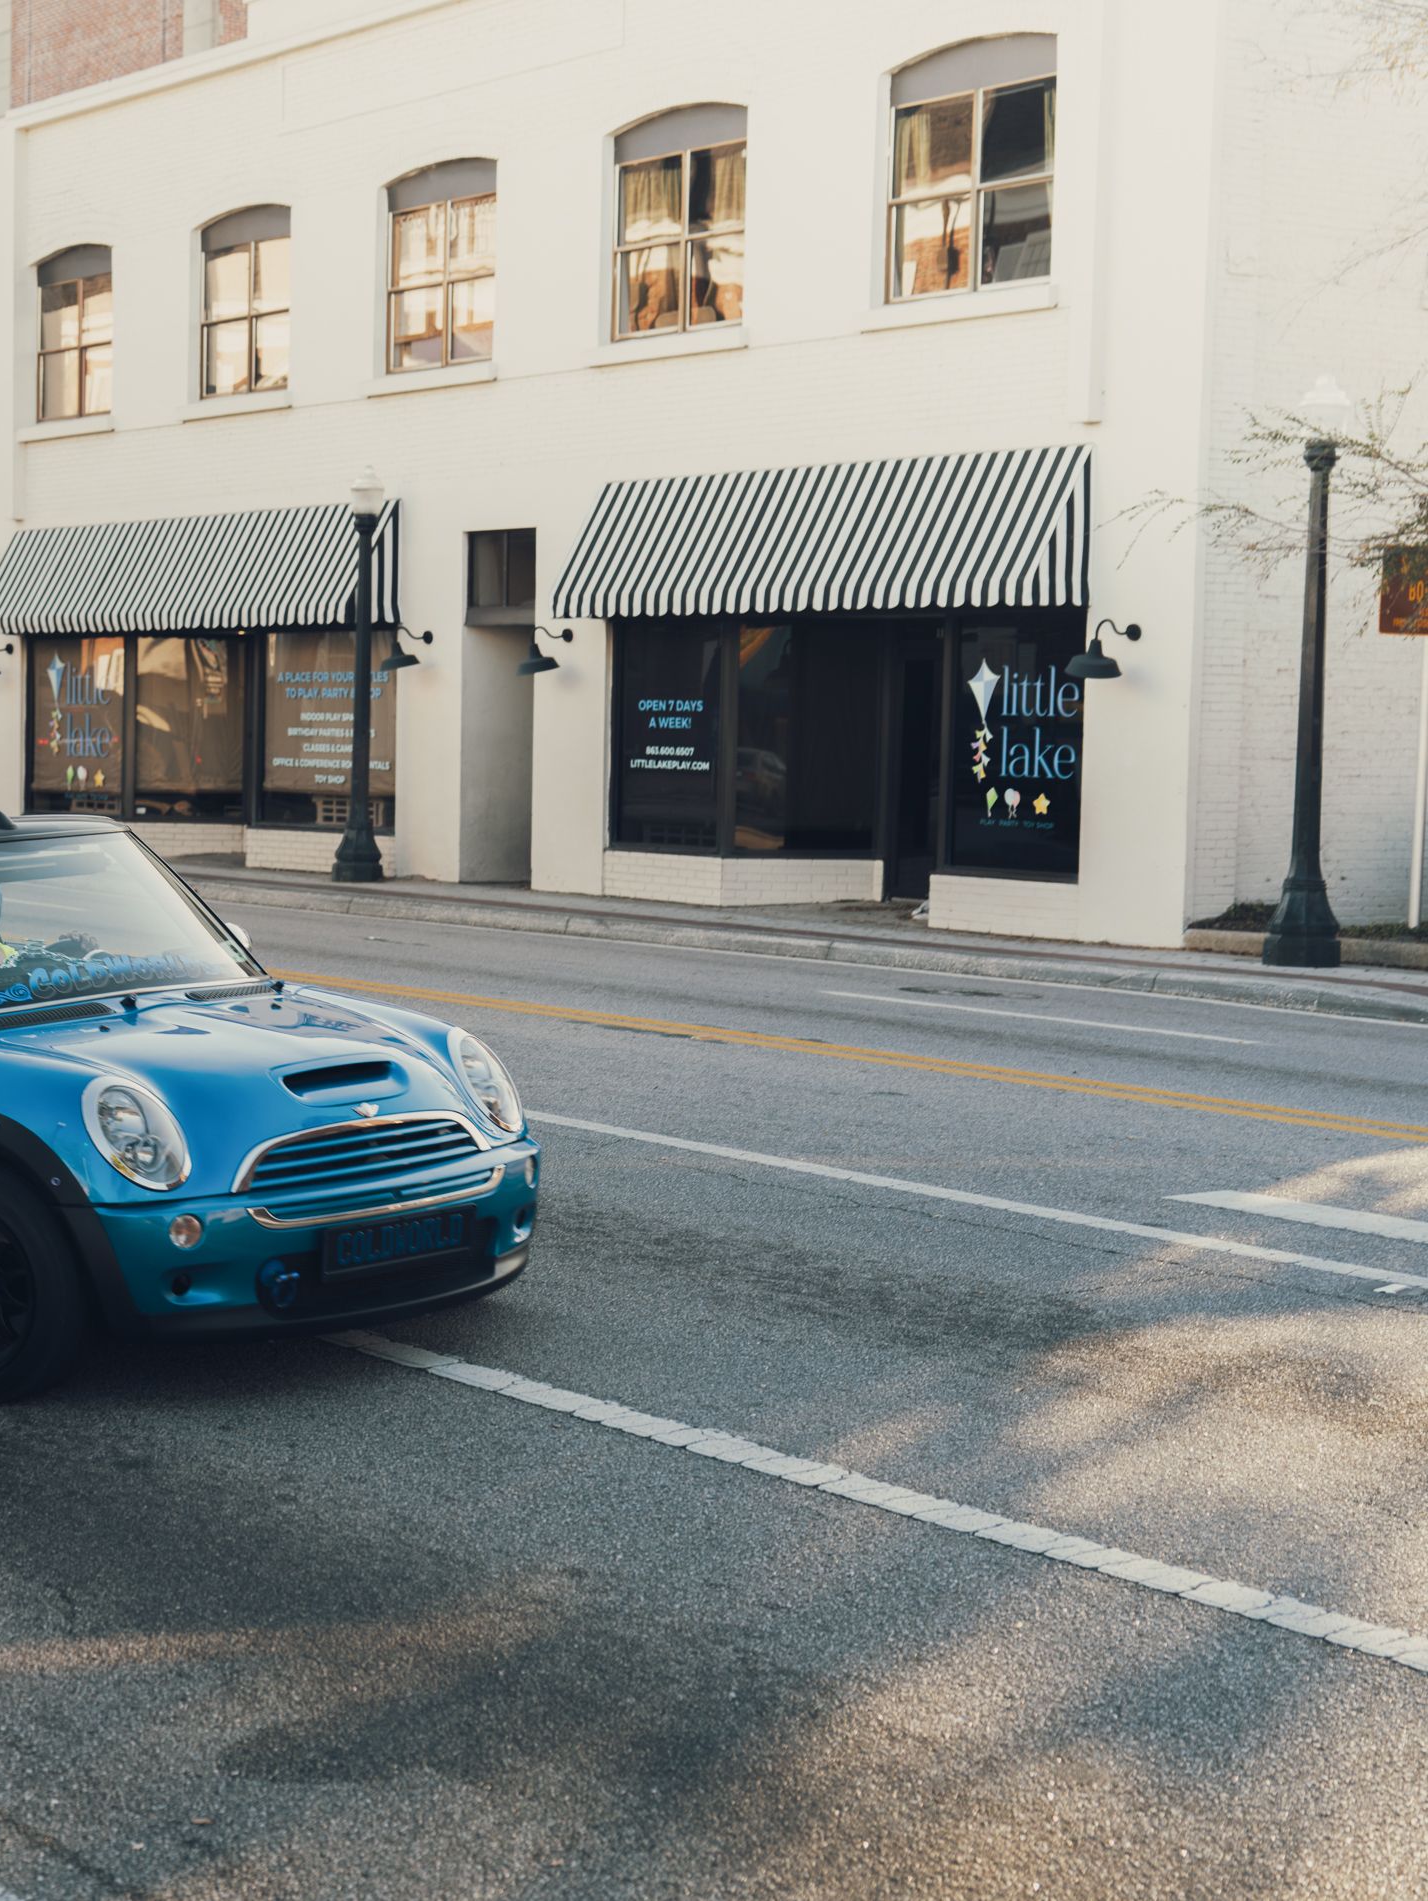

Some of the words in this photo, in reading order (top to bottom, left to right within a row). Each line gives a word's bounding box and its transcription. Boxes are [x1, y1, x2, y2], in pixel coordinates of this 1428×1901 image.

[66, 661, 111, 705] little
[285, 671, 311, 683] PLACE
[313, 671, 329, 683] FOR
[285, 687, 296, 698] TO
[322, 687, 349, 698] PARTY
[1001, 665, 1080, 718] little
[638, 699, 666, 711] OPEN
[668, 699, 674, 711] 7
[675, 700, 703, 712] DAYS
[300, 712, 325, 721] INDOOR
[325, 712, 341, 721] PLAY
[648, 716, 657, 728] A
[658, 716, 692, 729] WEEK!
[66, 713, 110, 758] lake
[287, 727, 318, 737] BIRTHDAY
[302, 743, 330, 752] CLASSES
[999, 725, 1076, 780] lake
[272, 757, 294, 767] OFFICE
[299, 758, 341, 768] CONFERENCE
[630, 759, 710, 771] LITTLELAKEPLAY.COM
[314, 774, 326, 783] TOY
[327, 774, 346, 784] SHOP
[998, 819, 1019, 827] PARTY
[1023, 820, 1035, 828] TOY
[1035, 821, 1055, 829] SHOP
[336, 1213, 463, 1266] COLDWORLD
